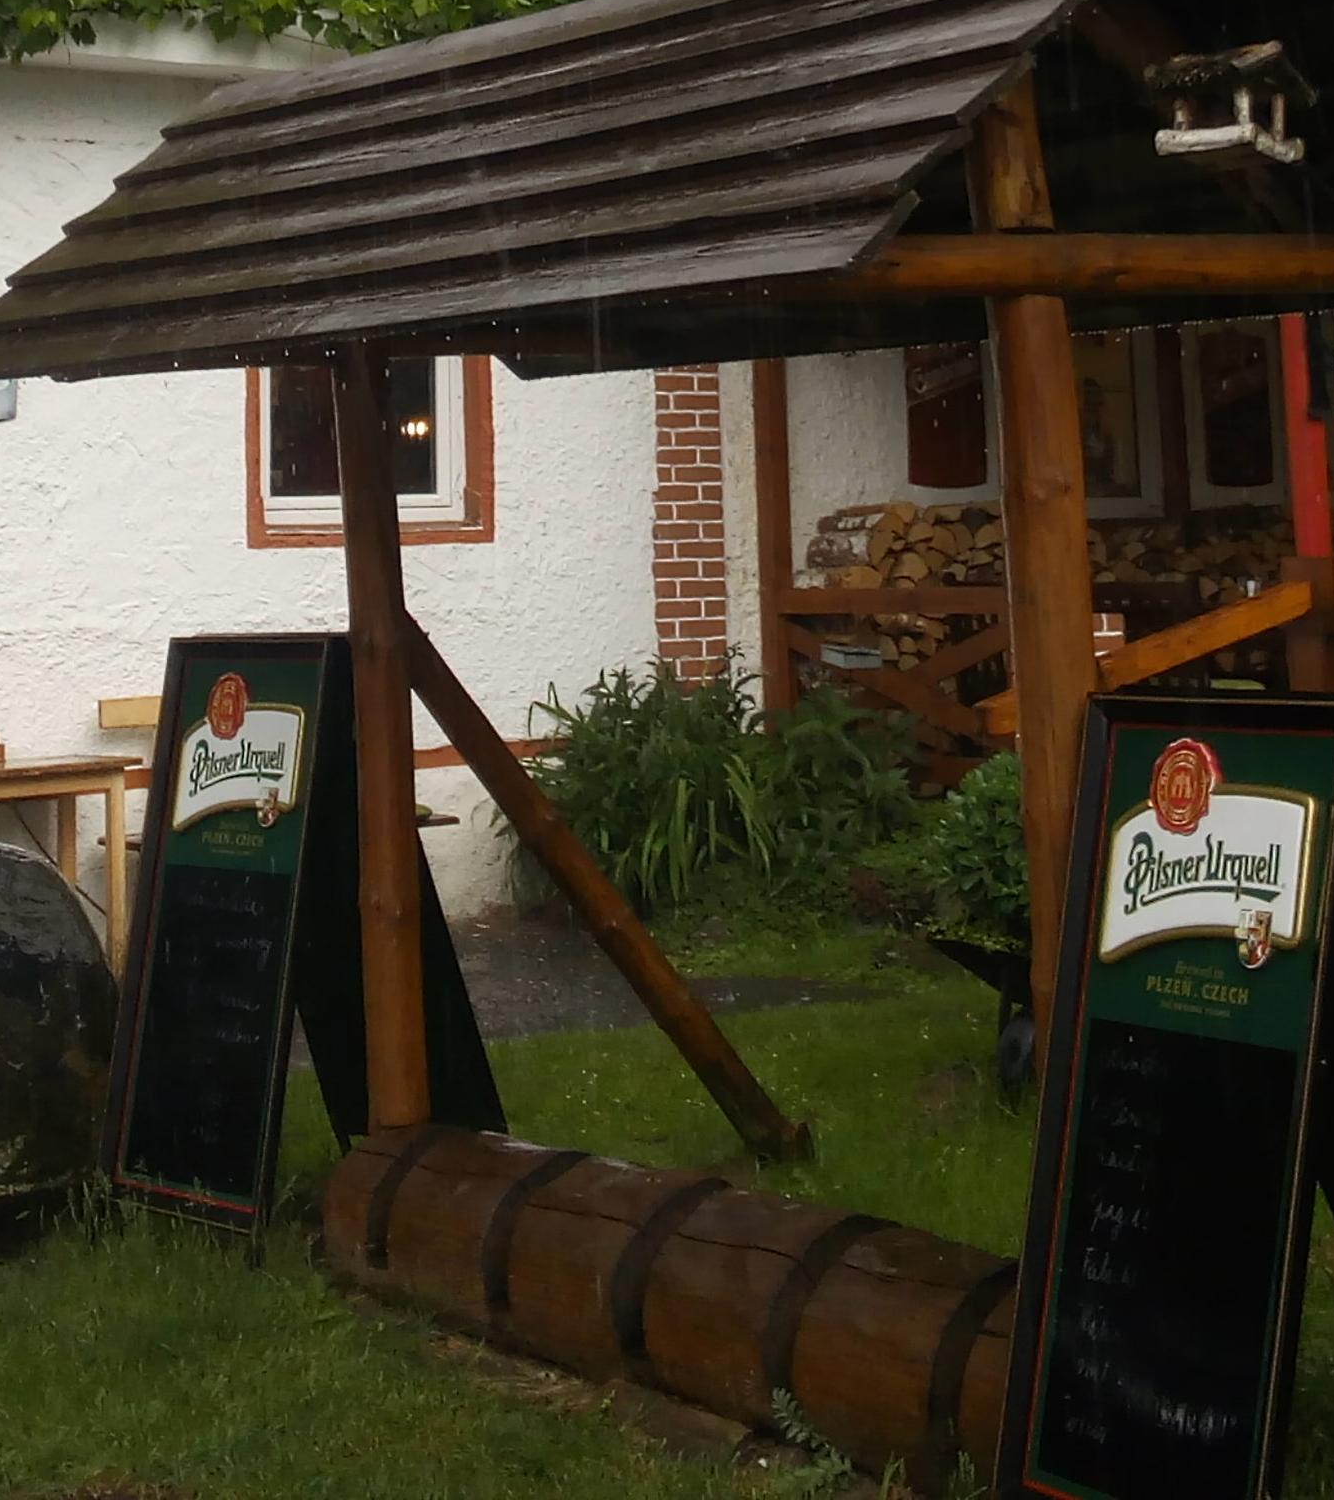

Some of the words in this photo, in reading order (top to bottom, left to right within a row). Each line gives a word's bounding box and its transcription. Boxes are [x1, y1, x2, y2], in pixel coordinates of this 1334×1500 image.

[188, 739, 240, 798] Pilsner
[239, 739, 286, 783] Urquell
[1124, 831, 1207, 915] Pilsner
[1205, 833, 1281, 902] Urquell
